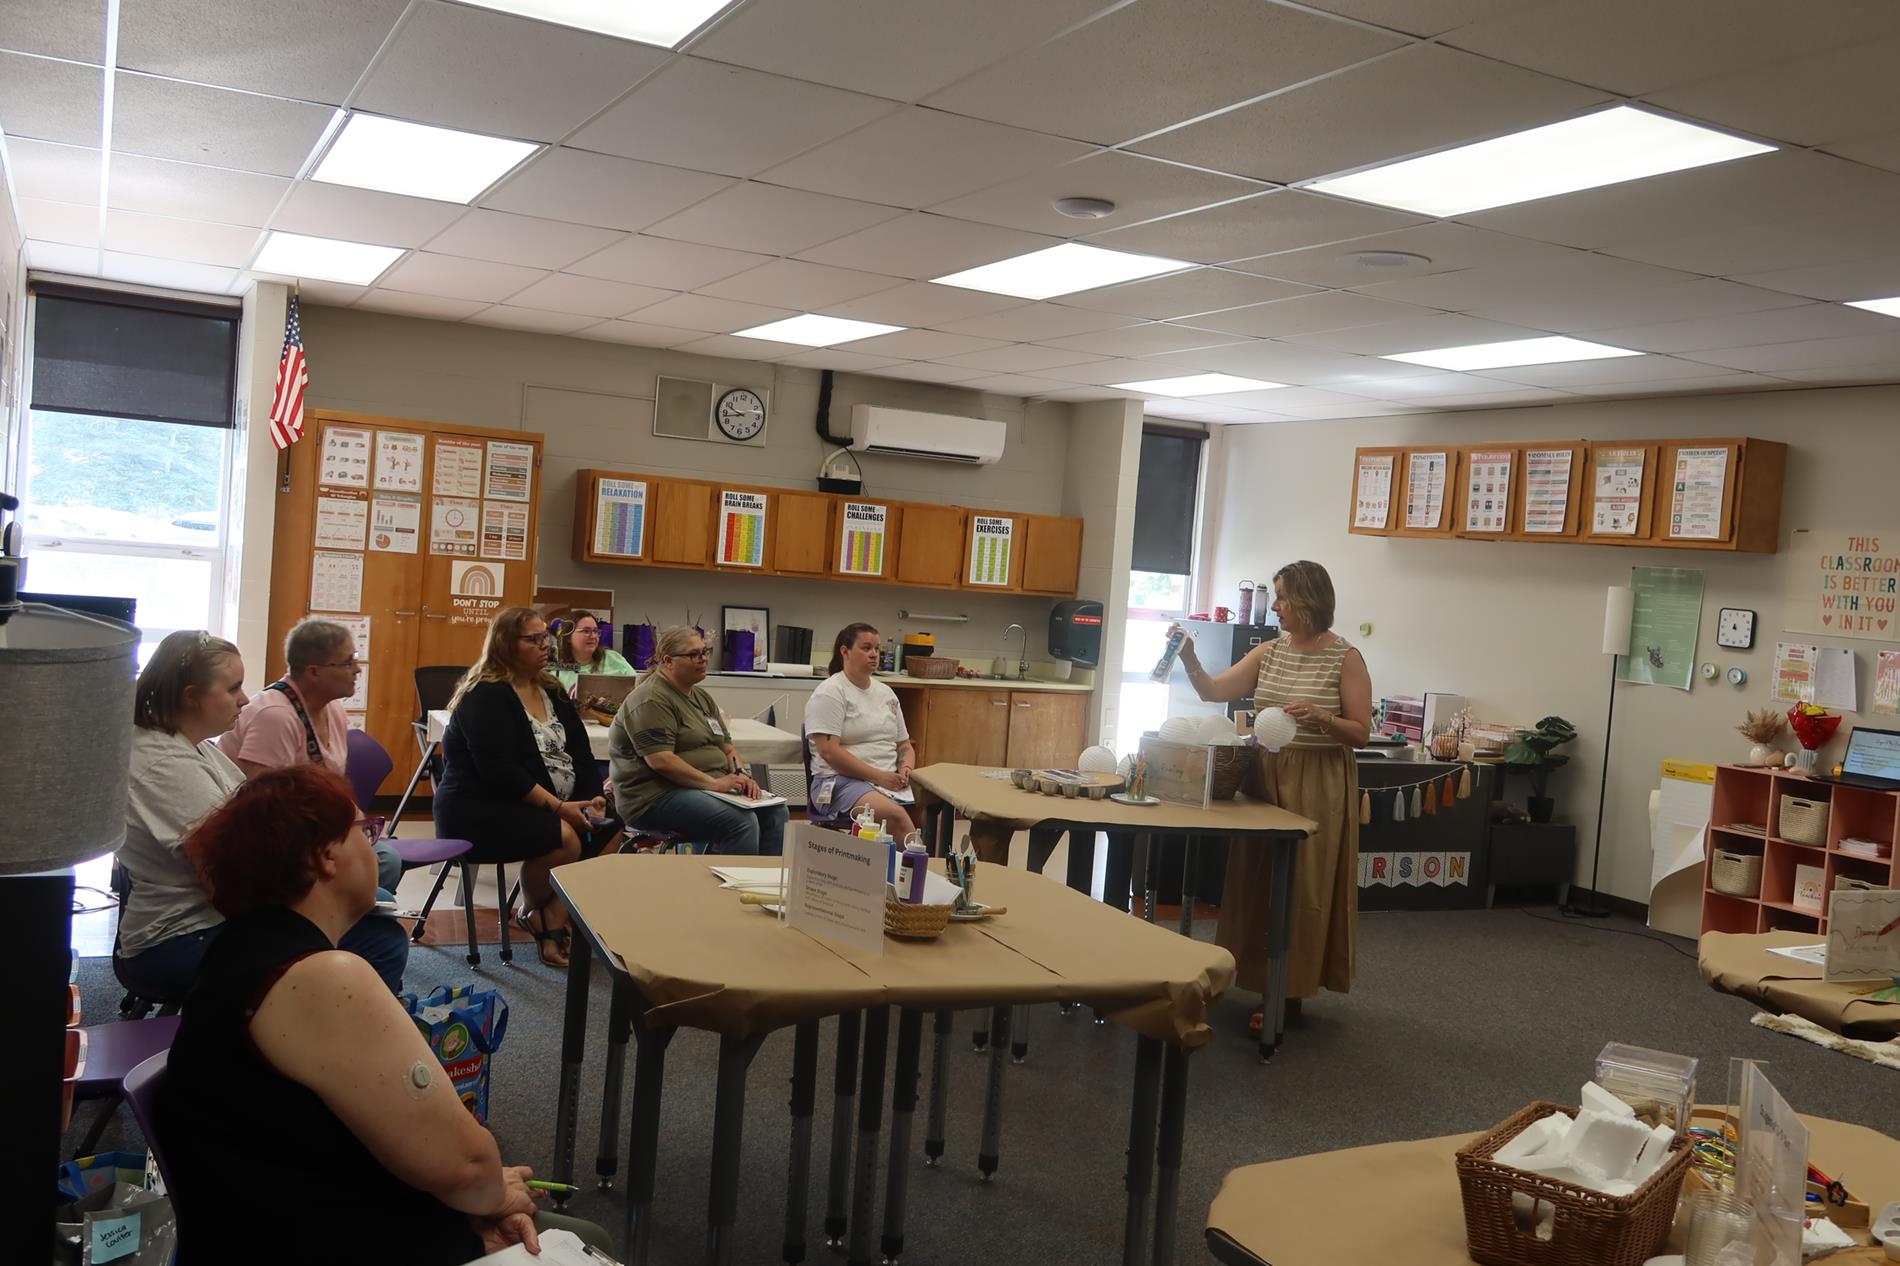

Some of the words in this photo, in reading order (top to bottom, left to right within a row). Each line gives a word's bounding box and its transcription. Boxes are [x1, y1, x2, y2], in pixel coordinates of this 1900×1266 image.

[601, 488, 643, 499] RELAXATION
[846, 511, 884, 521] CHALLENGES
[976, 525, 1010, 534] EXERCISES
[1848, 536, 1880, 553] THIS
[1824, 574, 1837, 590] IS
[1843, 575, 1896, 592] BETTER
[453, 599, 476, 608] DON'T
[479, 600, 500, 609] STOP
[1823, 594, 1858, 611] WITH
[1866, 596, 1896, 613] YOU
[1838, 615, 1853, 630] IN
[1858, 616, 1873, 632] IT
[808, 840, 827, 853] Stages
[828, 846, 835, 855] of
[835, 848, 871, 866] Printmaking
[1372, 856, 1465, 879] RSON
[100, 1224, 127, 1242] Jessica
